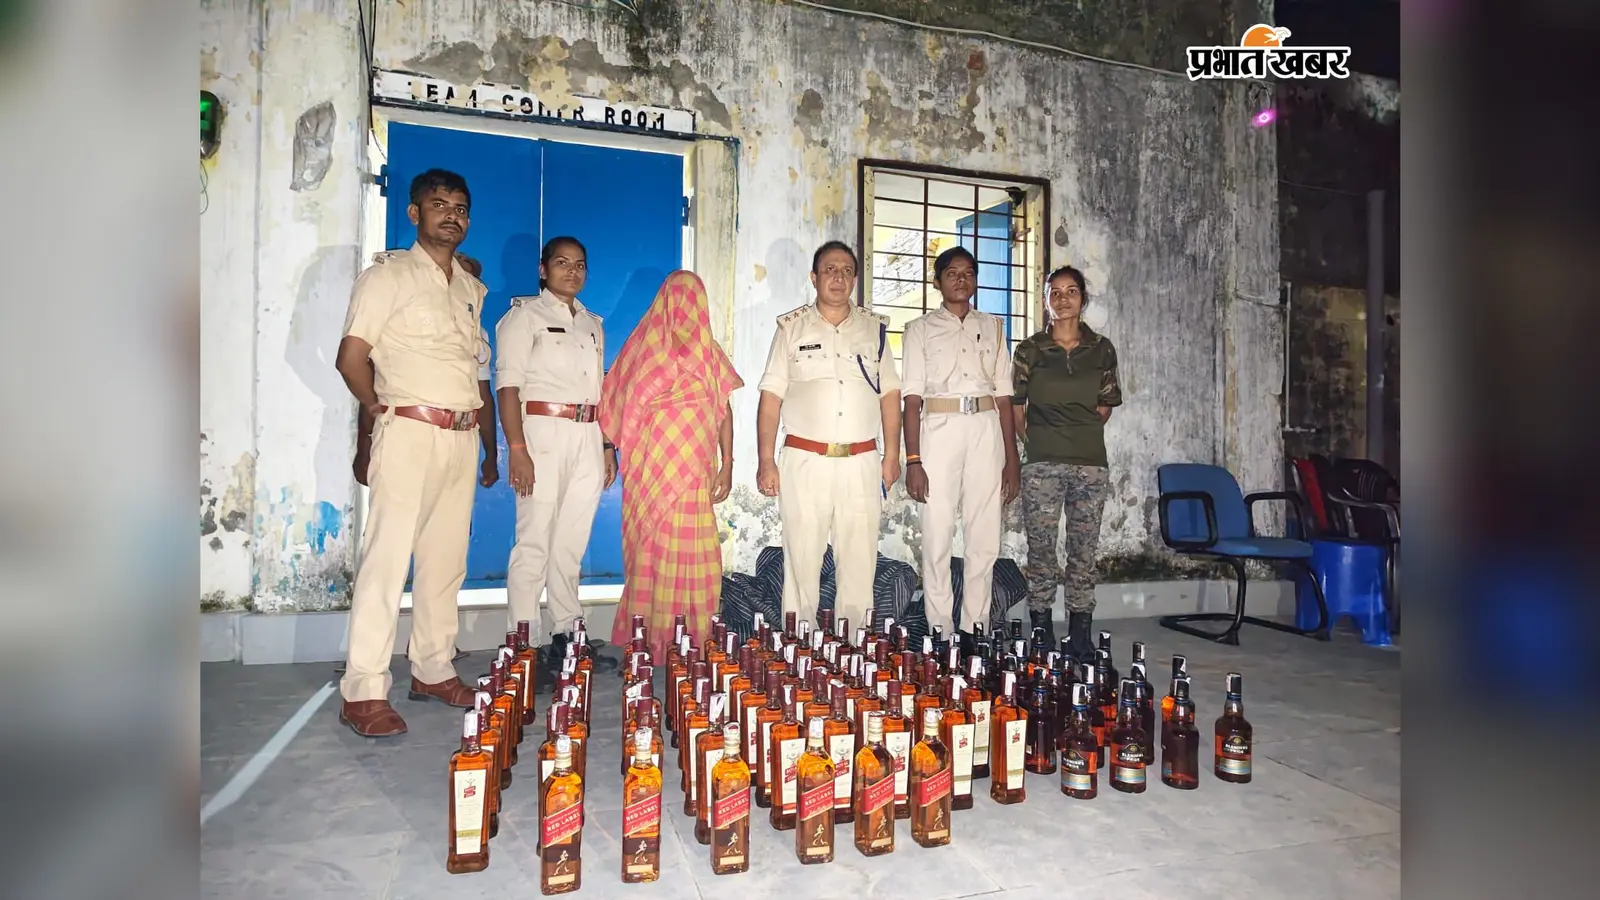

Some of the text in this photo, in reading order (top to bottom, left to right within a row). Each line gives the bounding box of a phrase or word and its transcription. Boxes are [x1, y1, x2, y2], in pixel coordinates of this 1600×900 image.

[604, 106, 665, 130] ROOM
[547, 822, 561, 832] RED
[561, 812, 581, 825] LABEL
[626, 812, 639, 821] RED
